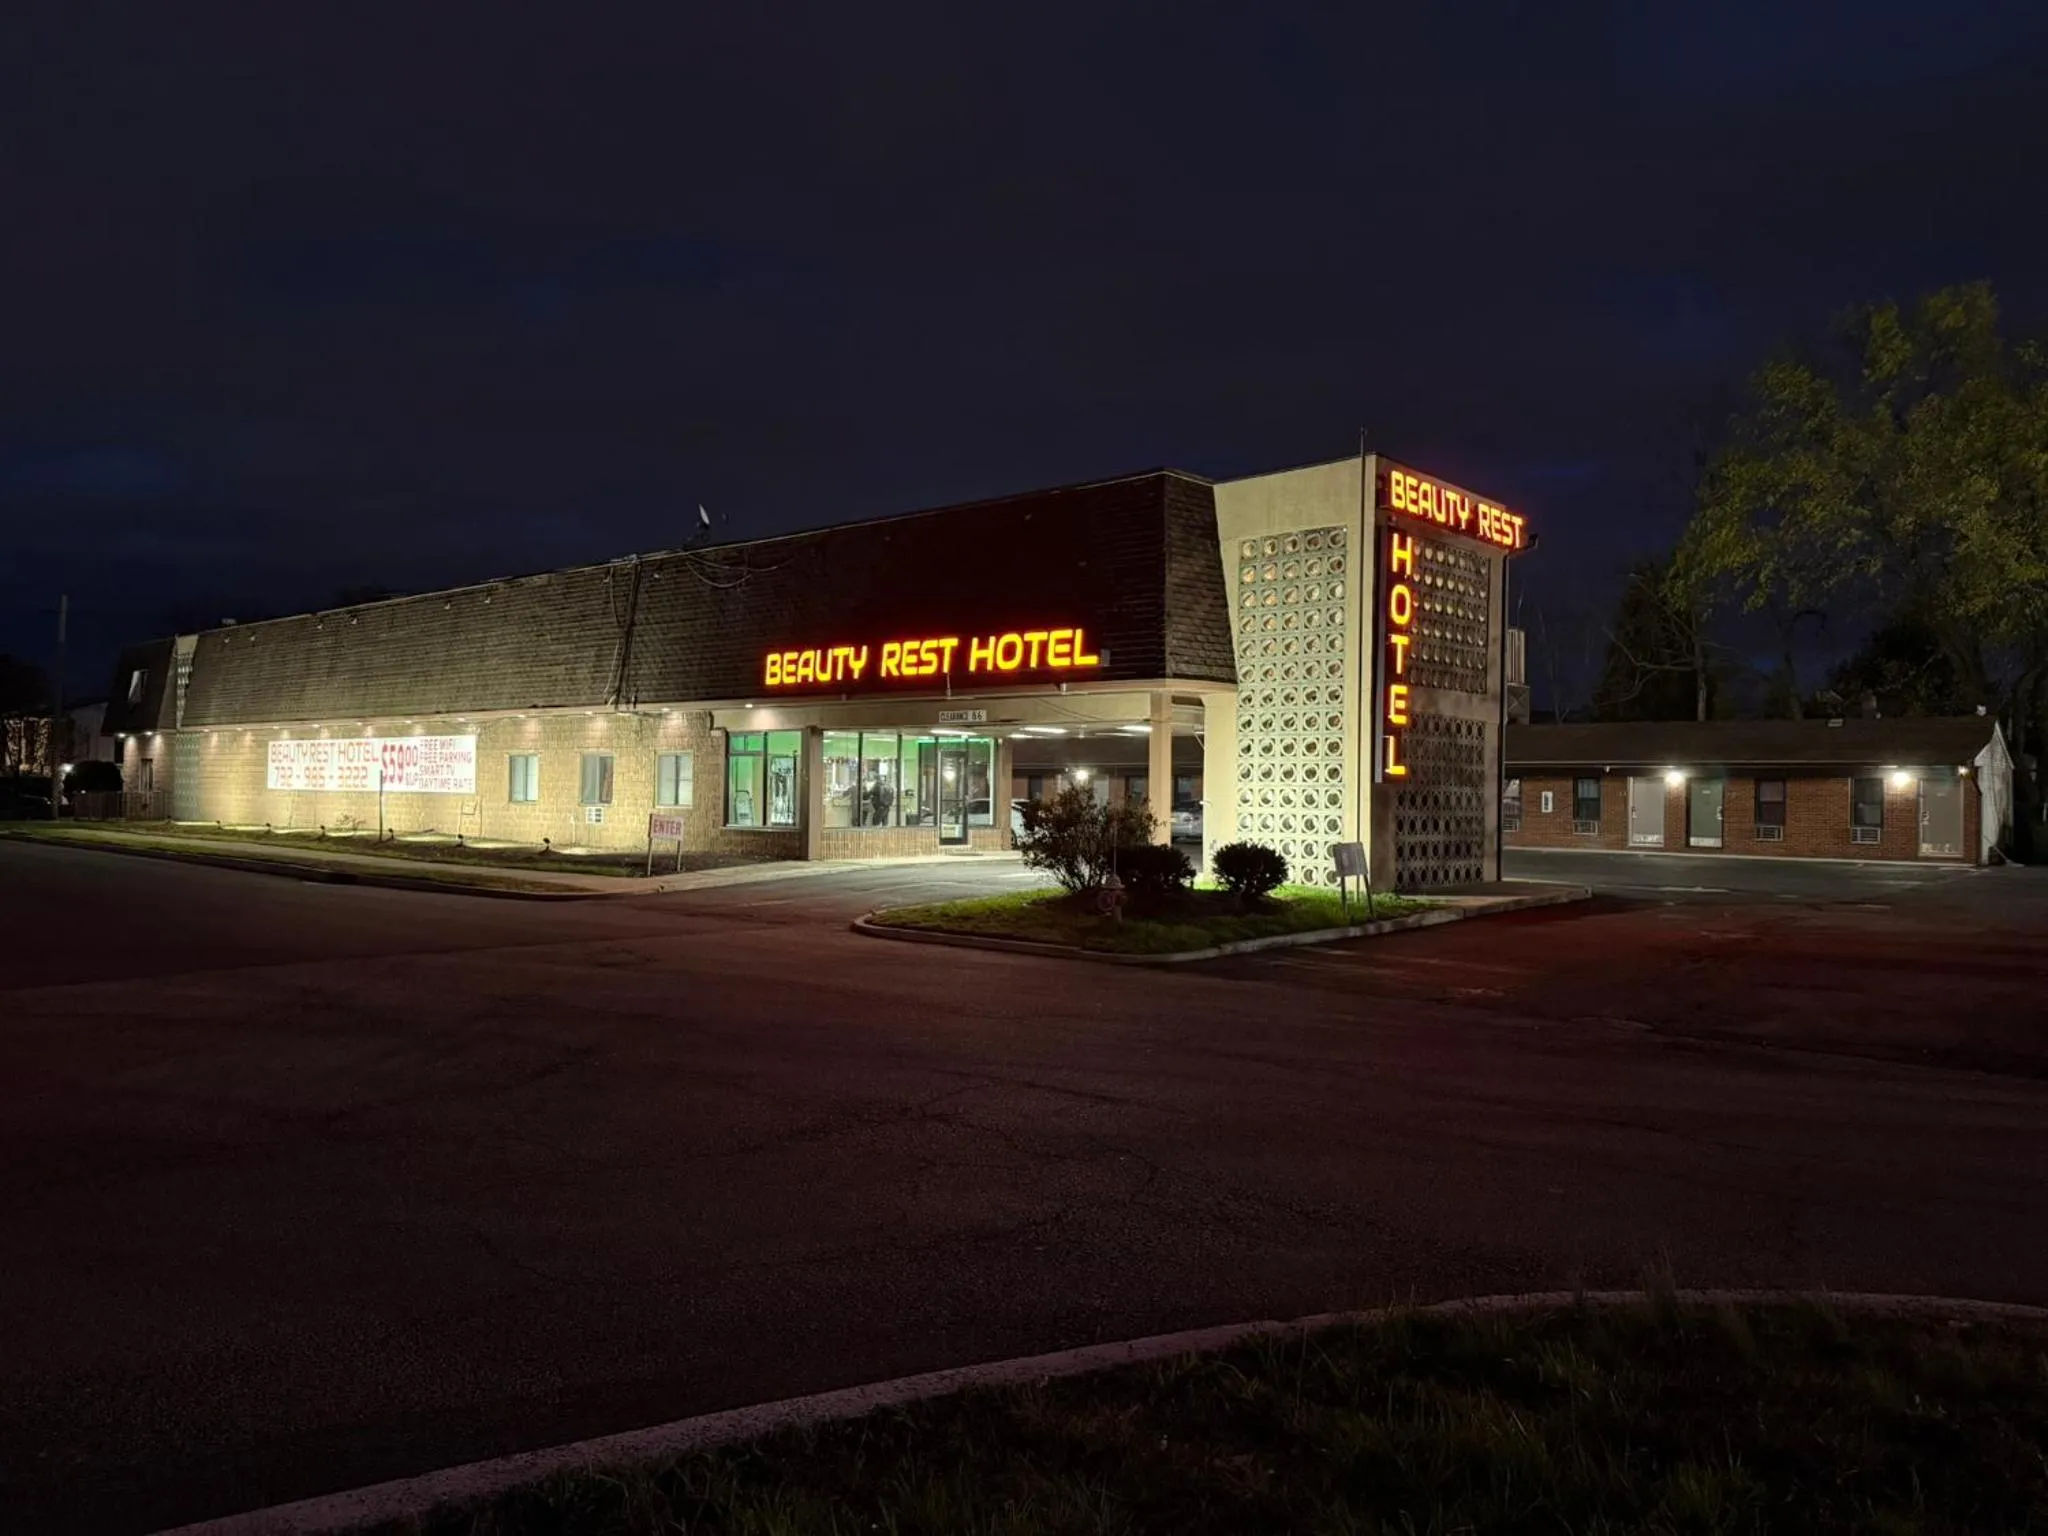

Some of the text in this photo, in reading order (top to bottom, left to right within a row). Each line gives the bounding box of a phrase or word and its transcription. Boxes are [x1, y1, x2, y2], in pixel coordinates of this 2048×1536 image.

[1390, 470, 1524, 549] BEAUTY REST
[765, 629, 1098, 686] BEAUTY REST HOTEL
[1386, 532, 1412, 775] HOTEL
[271, 741, 379, 763] BEAUTY REST HOTEL
[420, 738, 438, 750] FREE
[420, 751, 472, 763] FREE PARKING
[653, 818, 682, 836] ENTER
